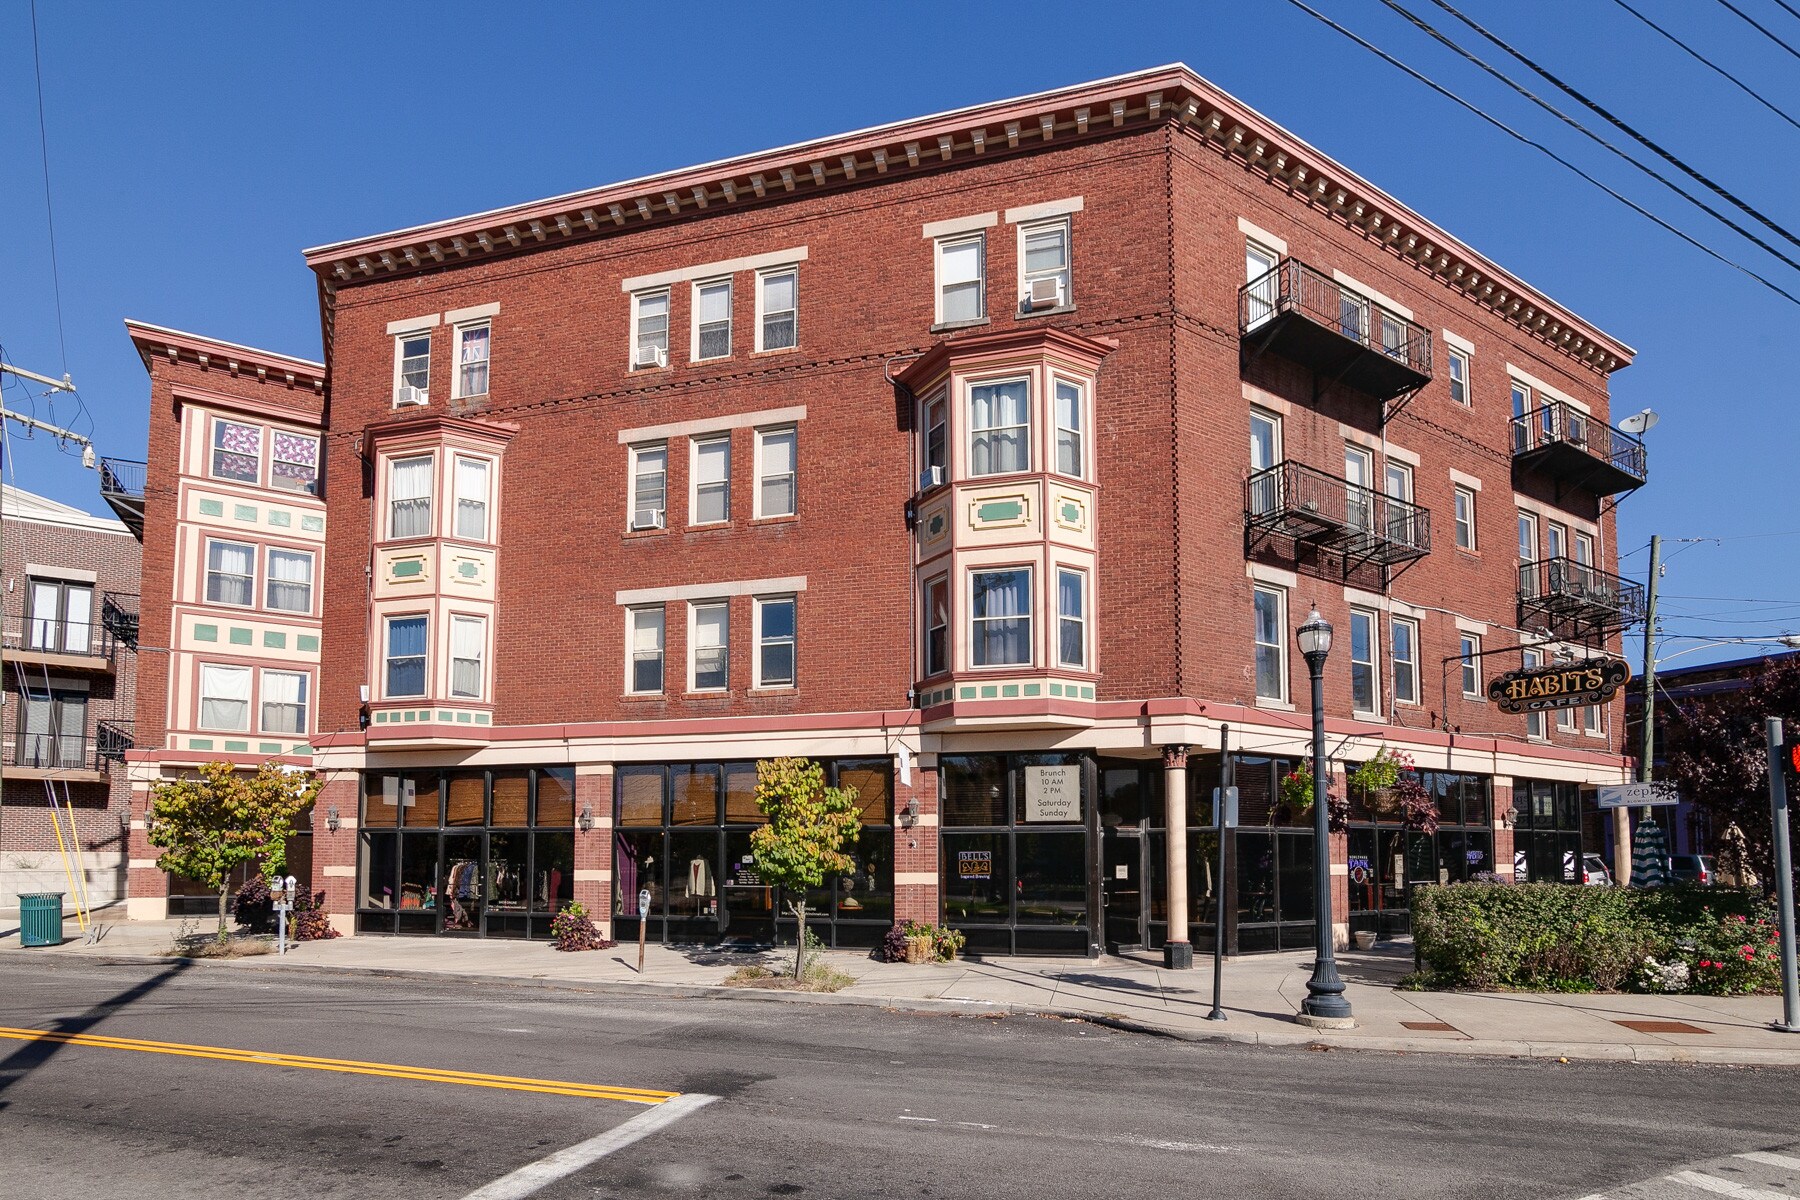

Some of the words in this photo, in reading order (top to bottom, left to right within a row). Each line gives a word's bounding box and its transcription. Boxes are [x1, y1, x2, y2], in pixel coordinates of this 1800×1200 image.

[1505, 668, 1603, 700] HABITS
[1529, 696, 1580, 709] CAFE
[1037, 799, 1072, 808] Saturday
[1039, 809, 1068, 818] Sunday
[961, 852, 989, 861] BELL'S
[1348, 859, 1369, 870] TANK
